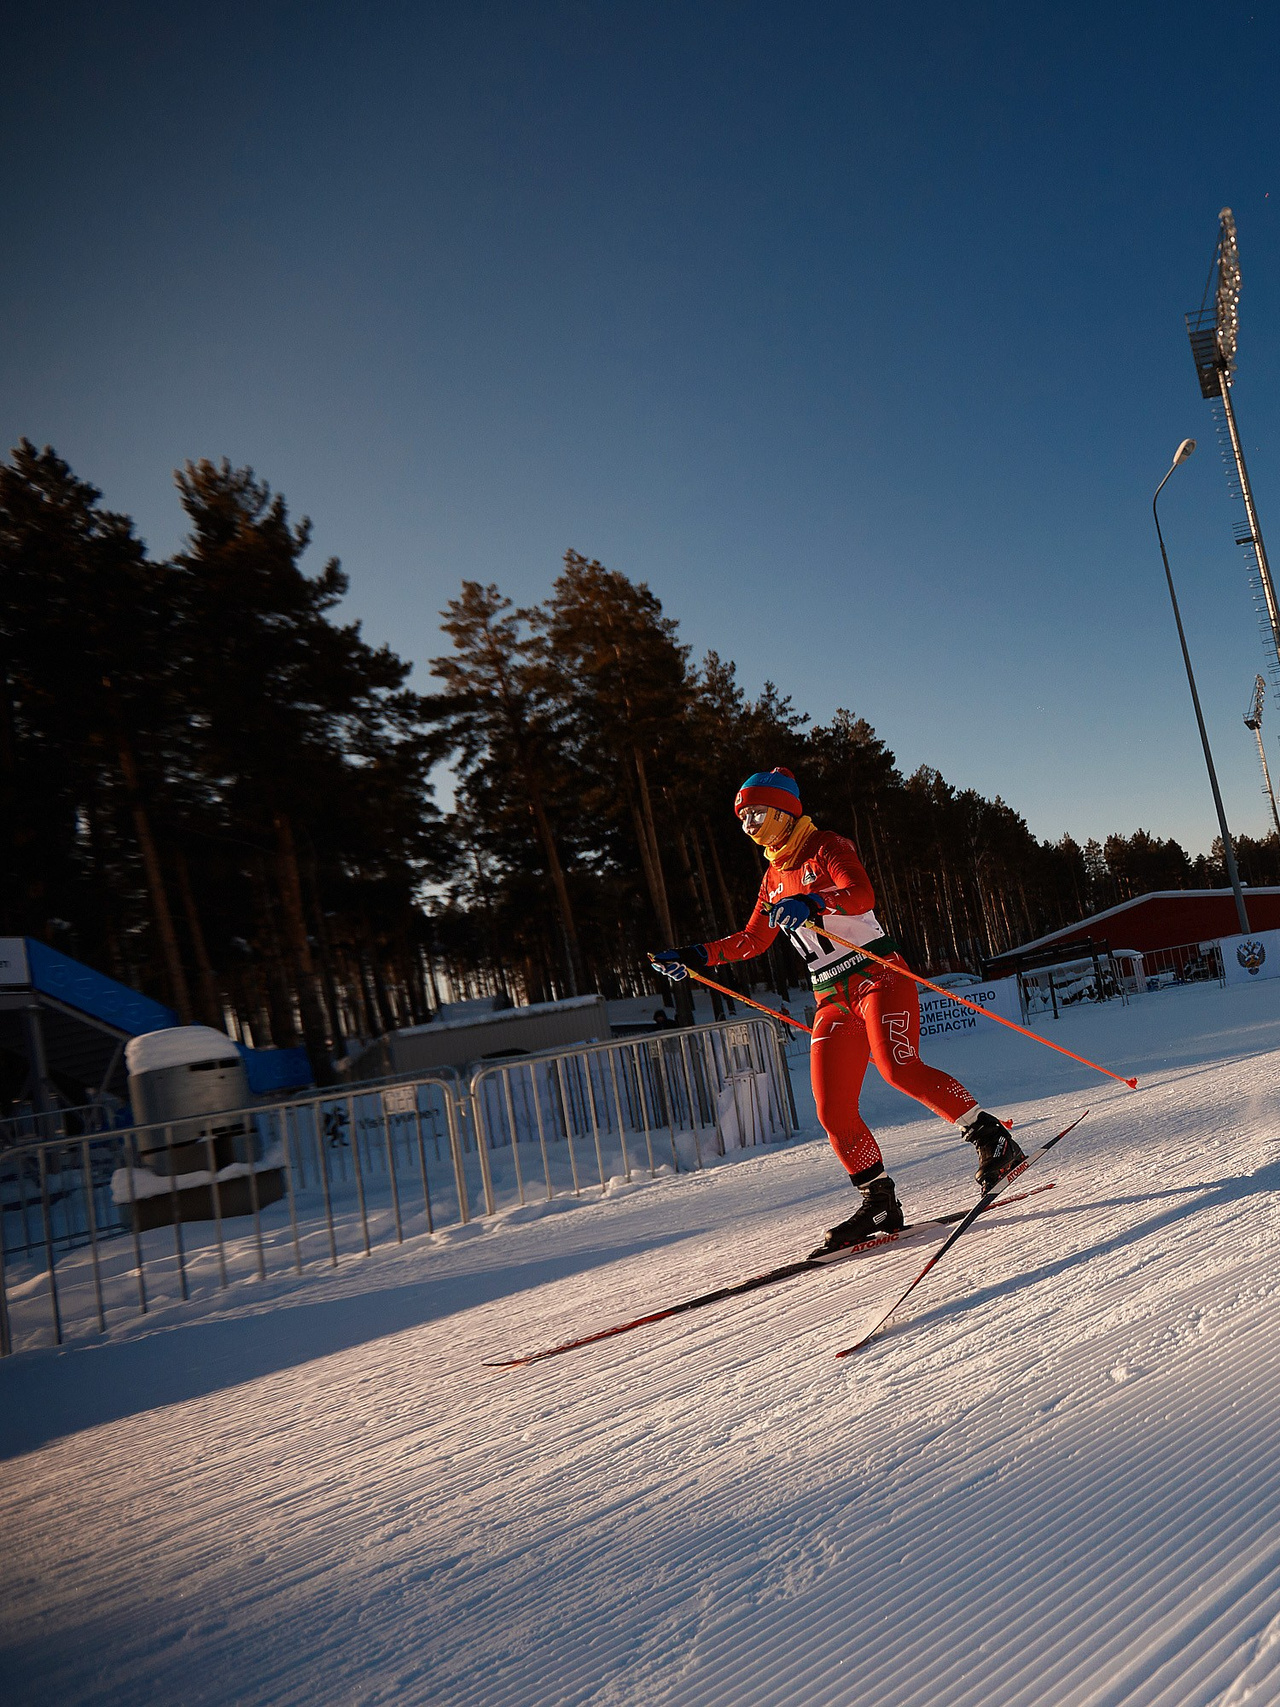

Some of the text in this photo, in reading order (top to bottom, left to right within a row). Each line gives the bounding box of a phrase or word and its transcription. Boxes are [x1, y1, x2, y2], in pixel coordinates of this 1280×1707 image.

[919, 1018, 976, 1036] ОБЛАСТИ
[1006, 1161, 1030, 1183] ATOMIC
[850, 1233, 900, 1254] ATOMIC
